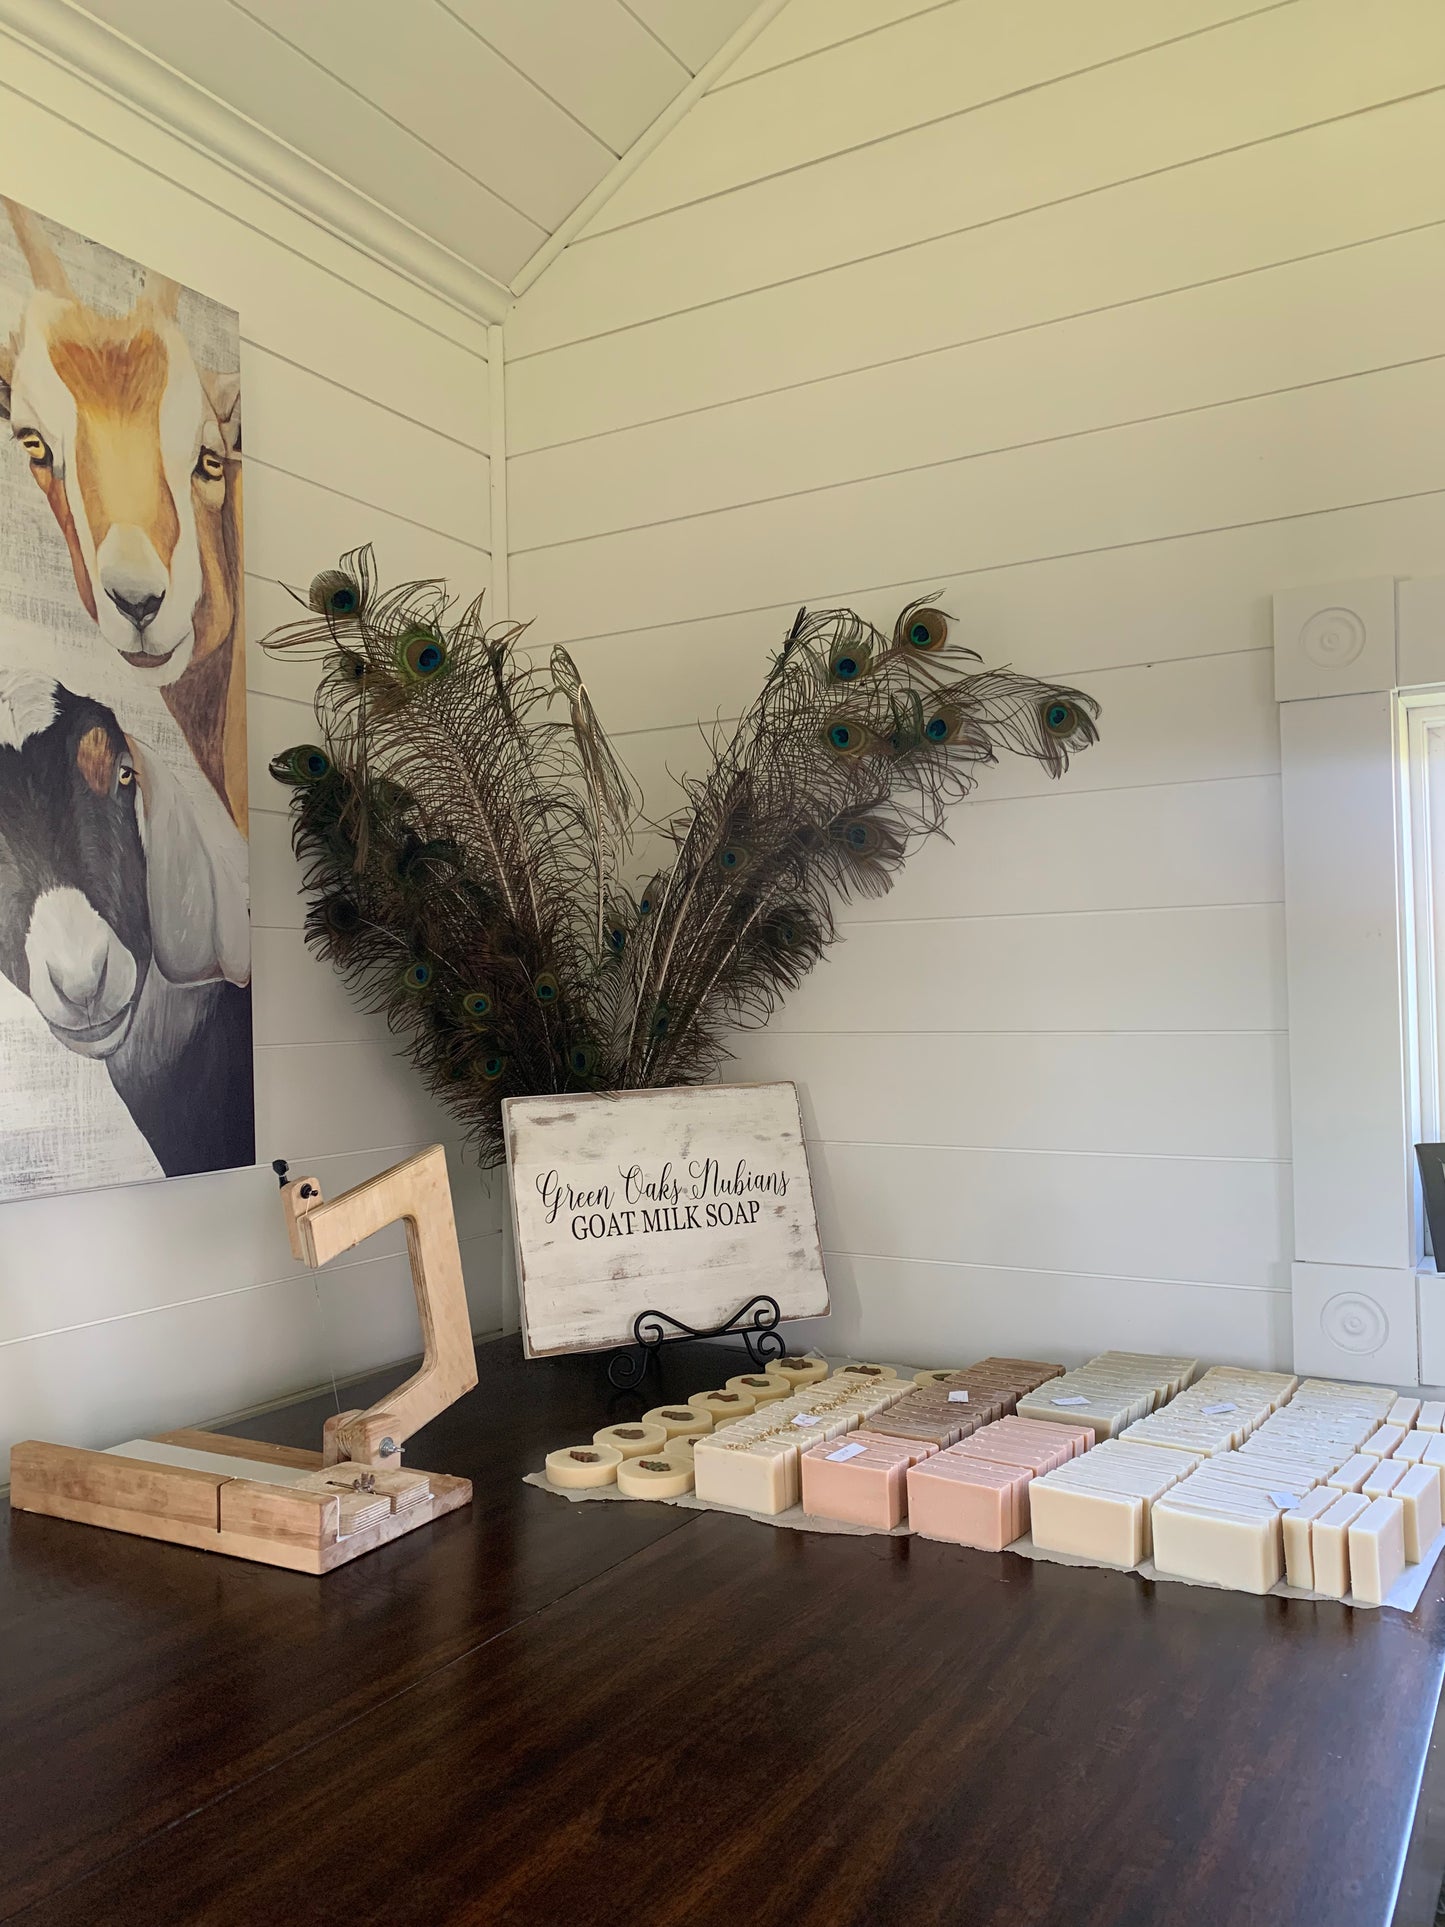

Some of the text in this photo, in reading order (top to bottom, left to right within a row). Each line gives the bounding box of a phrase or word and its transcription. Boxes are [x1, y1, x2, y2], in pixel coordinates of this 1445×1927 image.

[535, 1157, 790, 1224] Green Oaks Nubians
[571, 1200, 760, 1240] GOAT MILK SOAP
